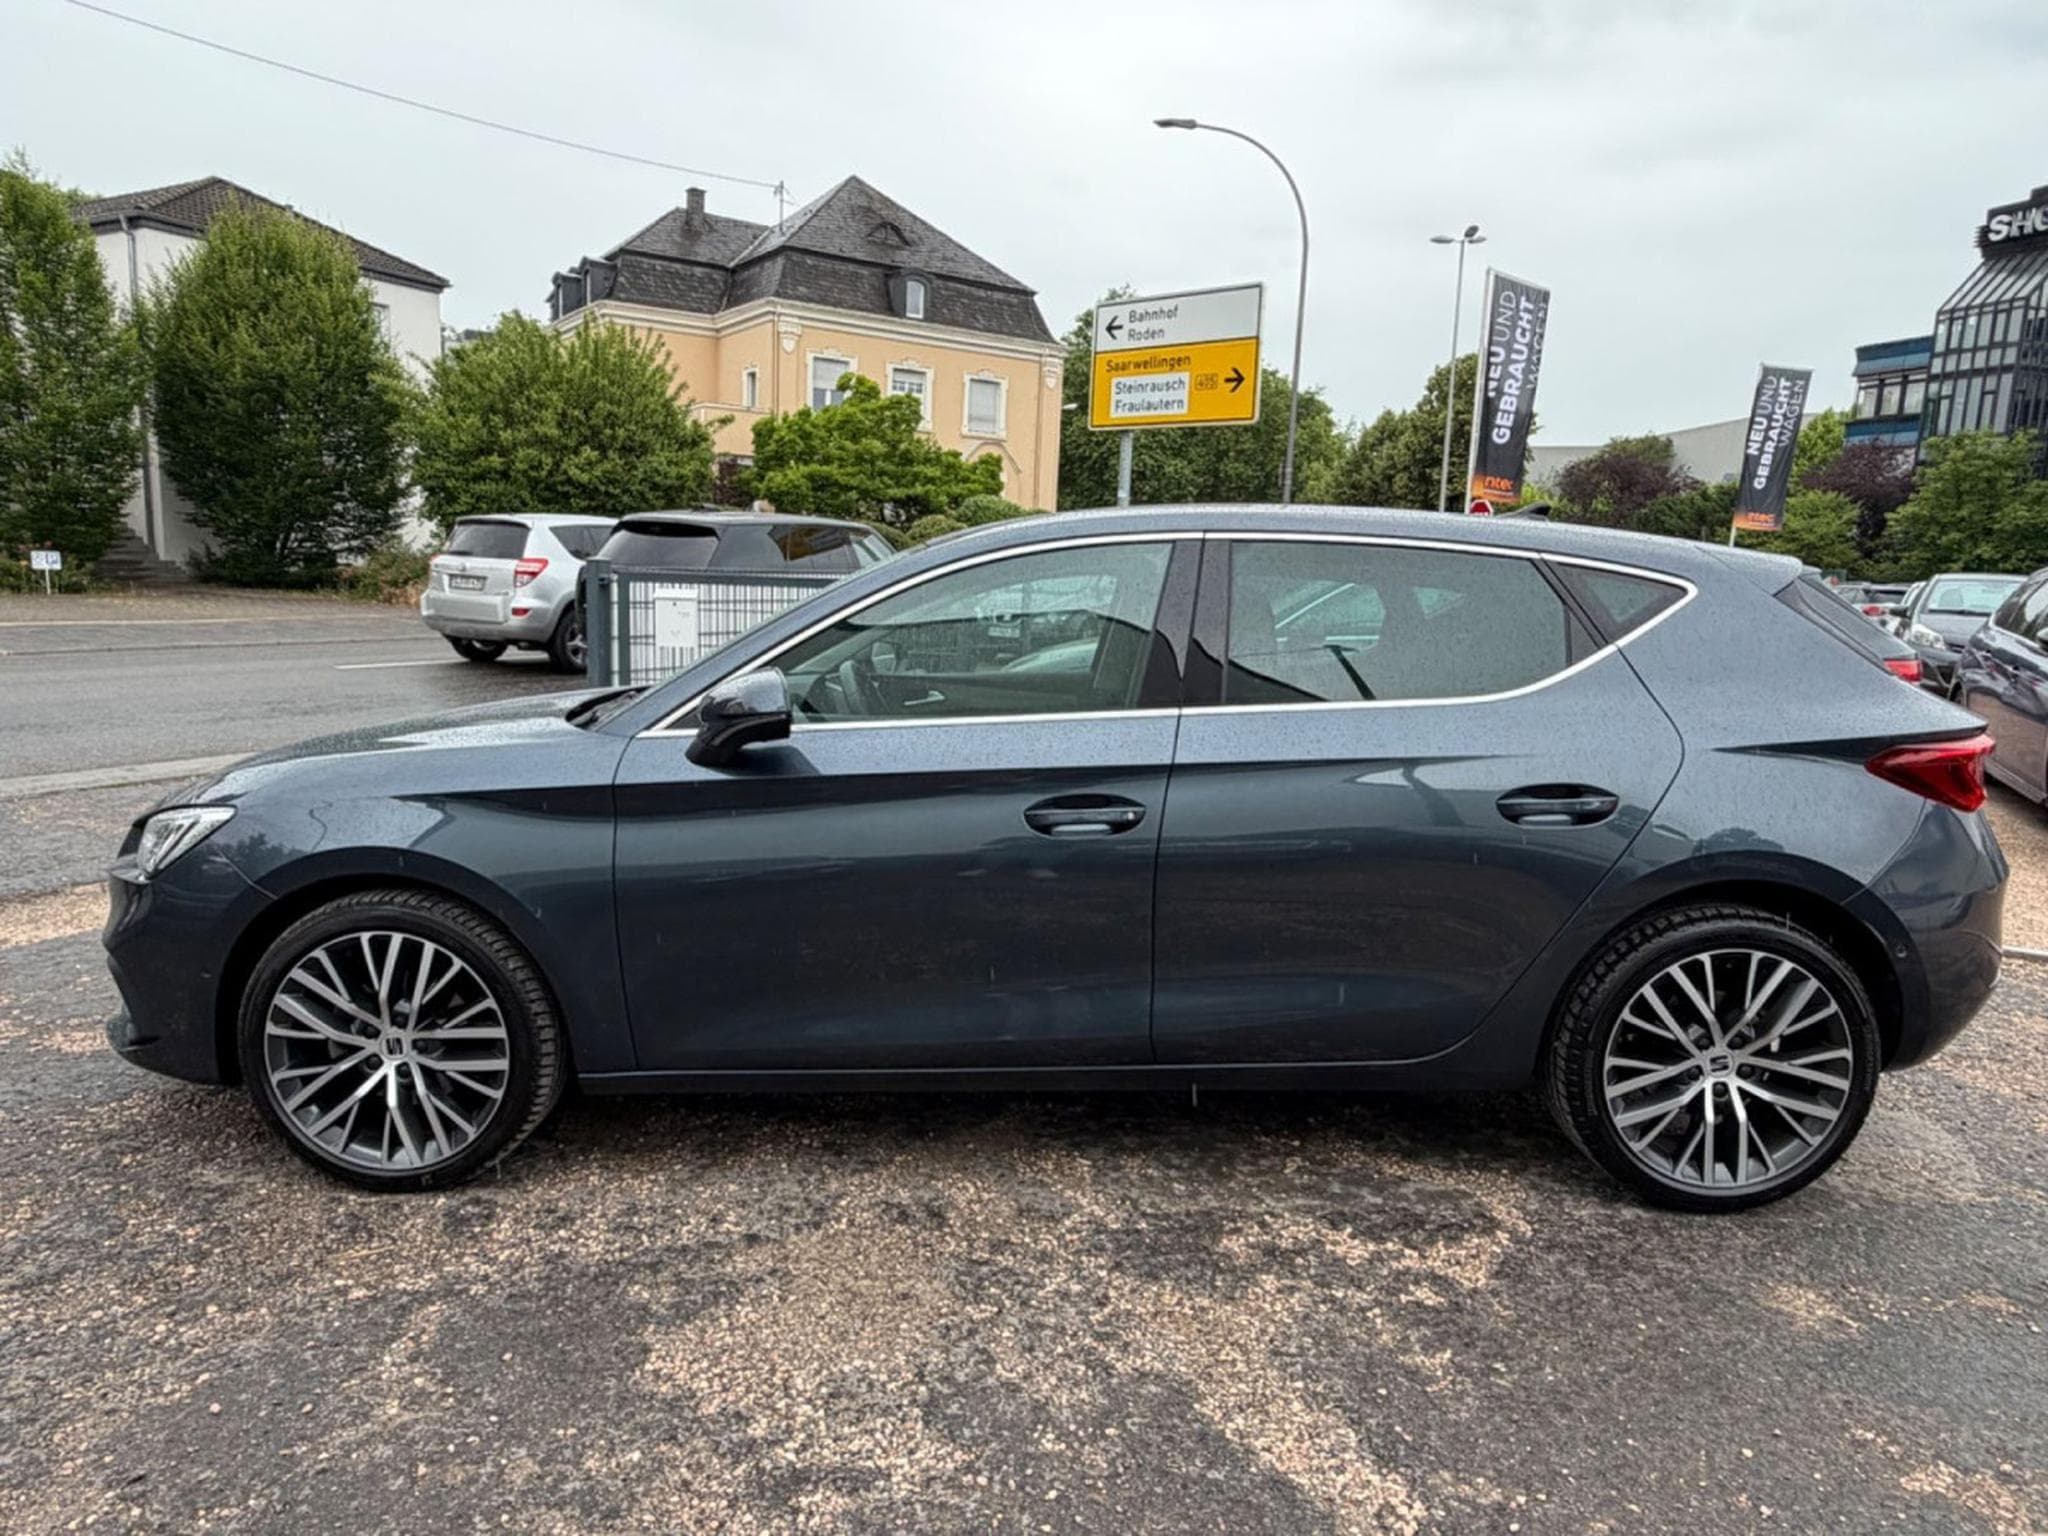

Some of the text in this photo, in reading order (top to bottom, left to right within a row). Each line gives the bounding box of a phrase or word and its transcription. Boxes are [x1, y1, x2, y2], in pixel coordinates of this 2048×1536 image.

[1129, 305, 1178, 323] Bahnhof
[1493, 291, 1516, 342] UND
[1128, 328, 1165, 341] Roden
[1106, 355, 1191, 373] Saarwellingen
[1492, 296, 1534, 444] GEBRAUCHT
[1115, 378, 1185, 395] Steinrausch
[1114, 399, 1184, 413] Fraulautern
[1779, 380, 1805, 447] WAGEN
[1747, 418, 1768, 455] NEU
[1753, 378, 1792, 489] GEBRAUCHT
